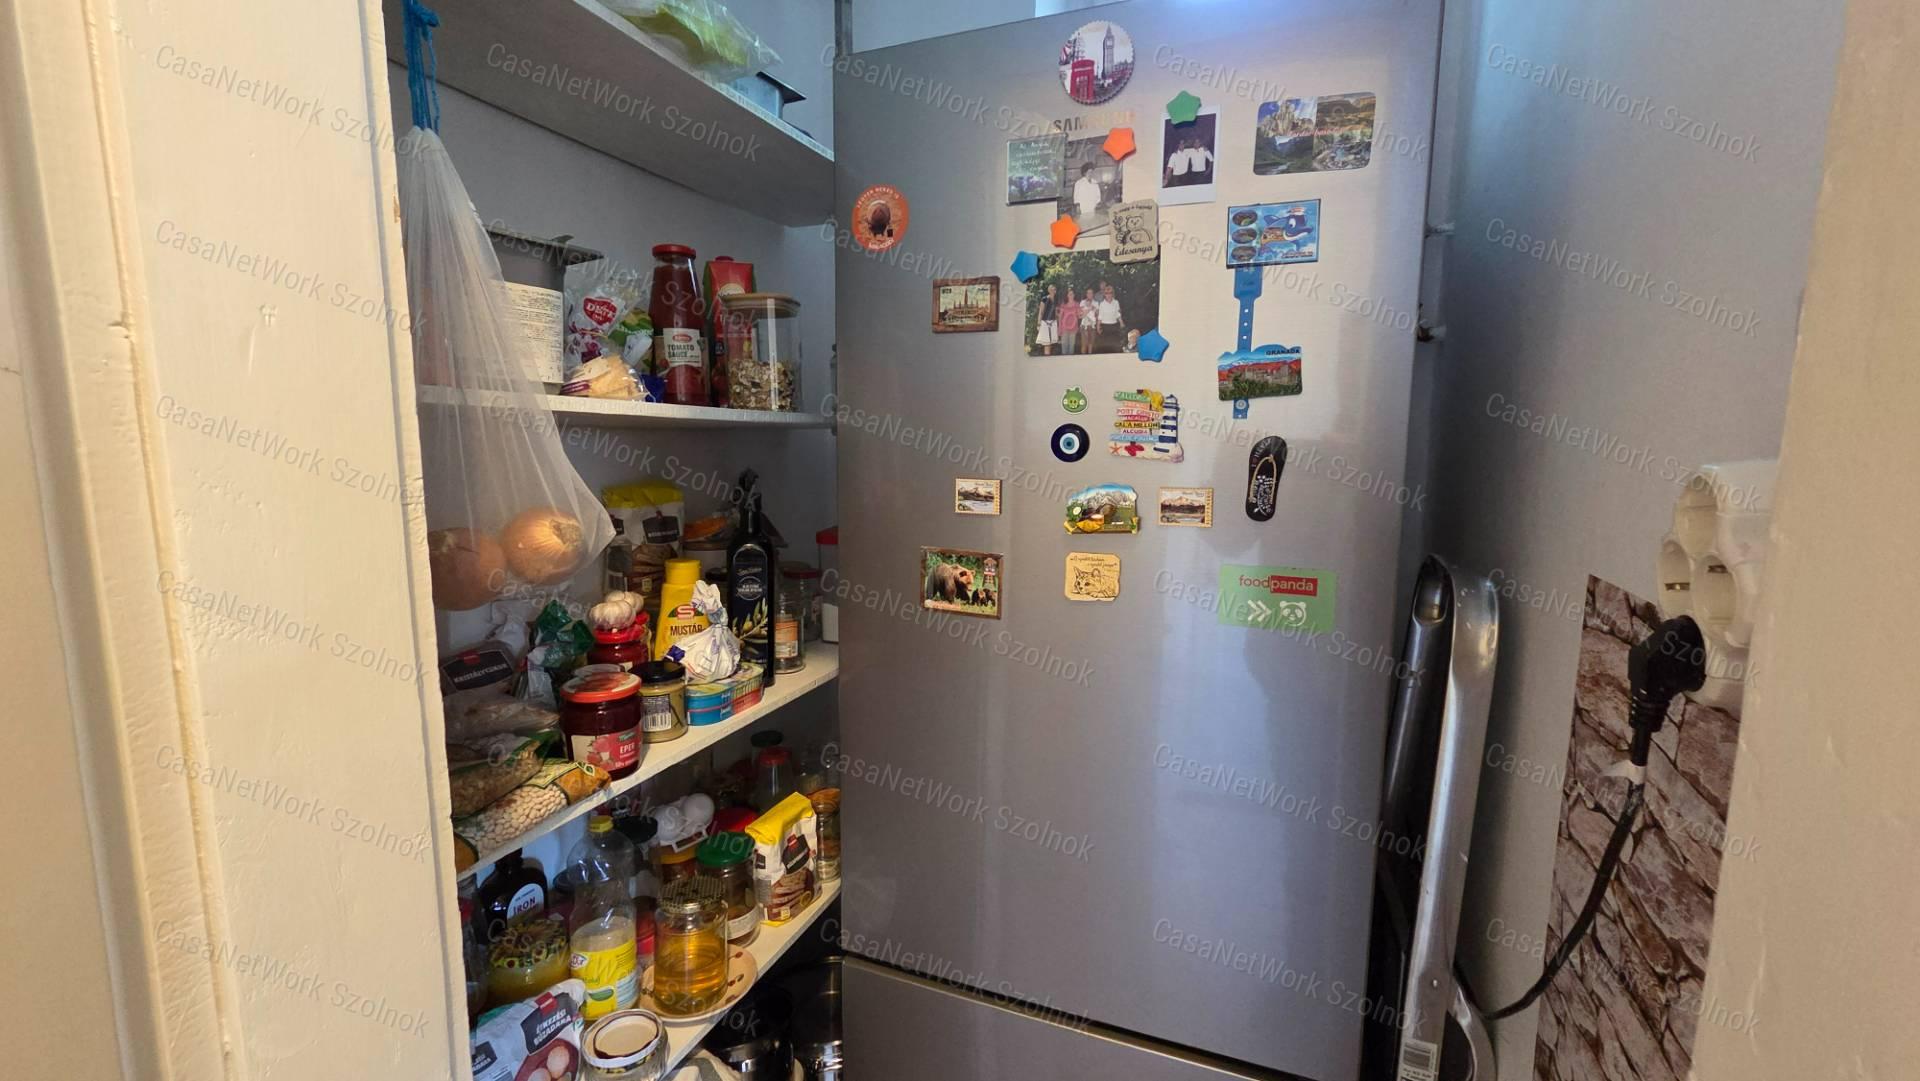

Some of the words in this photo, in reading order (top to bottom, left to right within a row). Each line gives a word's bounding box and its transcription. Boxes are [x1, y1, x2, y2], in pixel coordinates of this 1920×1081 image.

[1266, 348, 1300, 356] GRANADA
[1239, 575, 1314, 593] foodpanda
[670, 623, 703, 637] MUSTÁR
